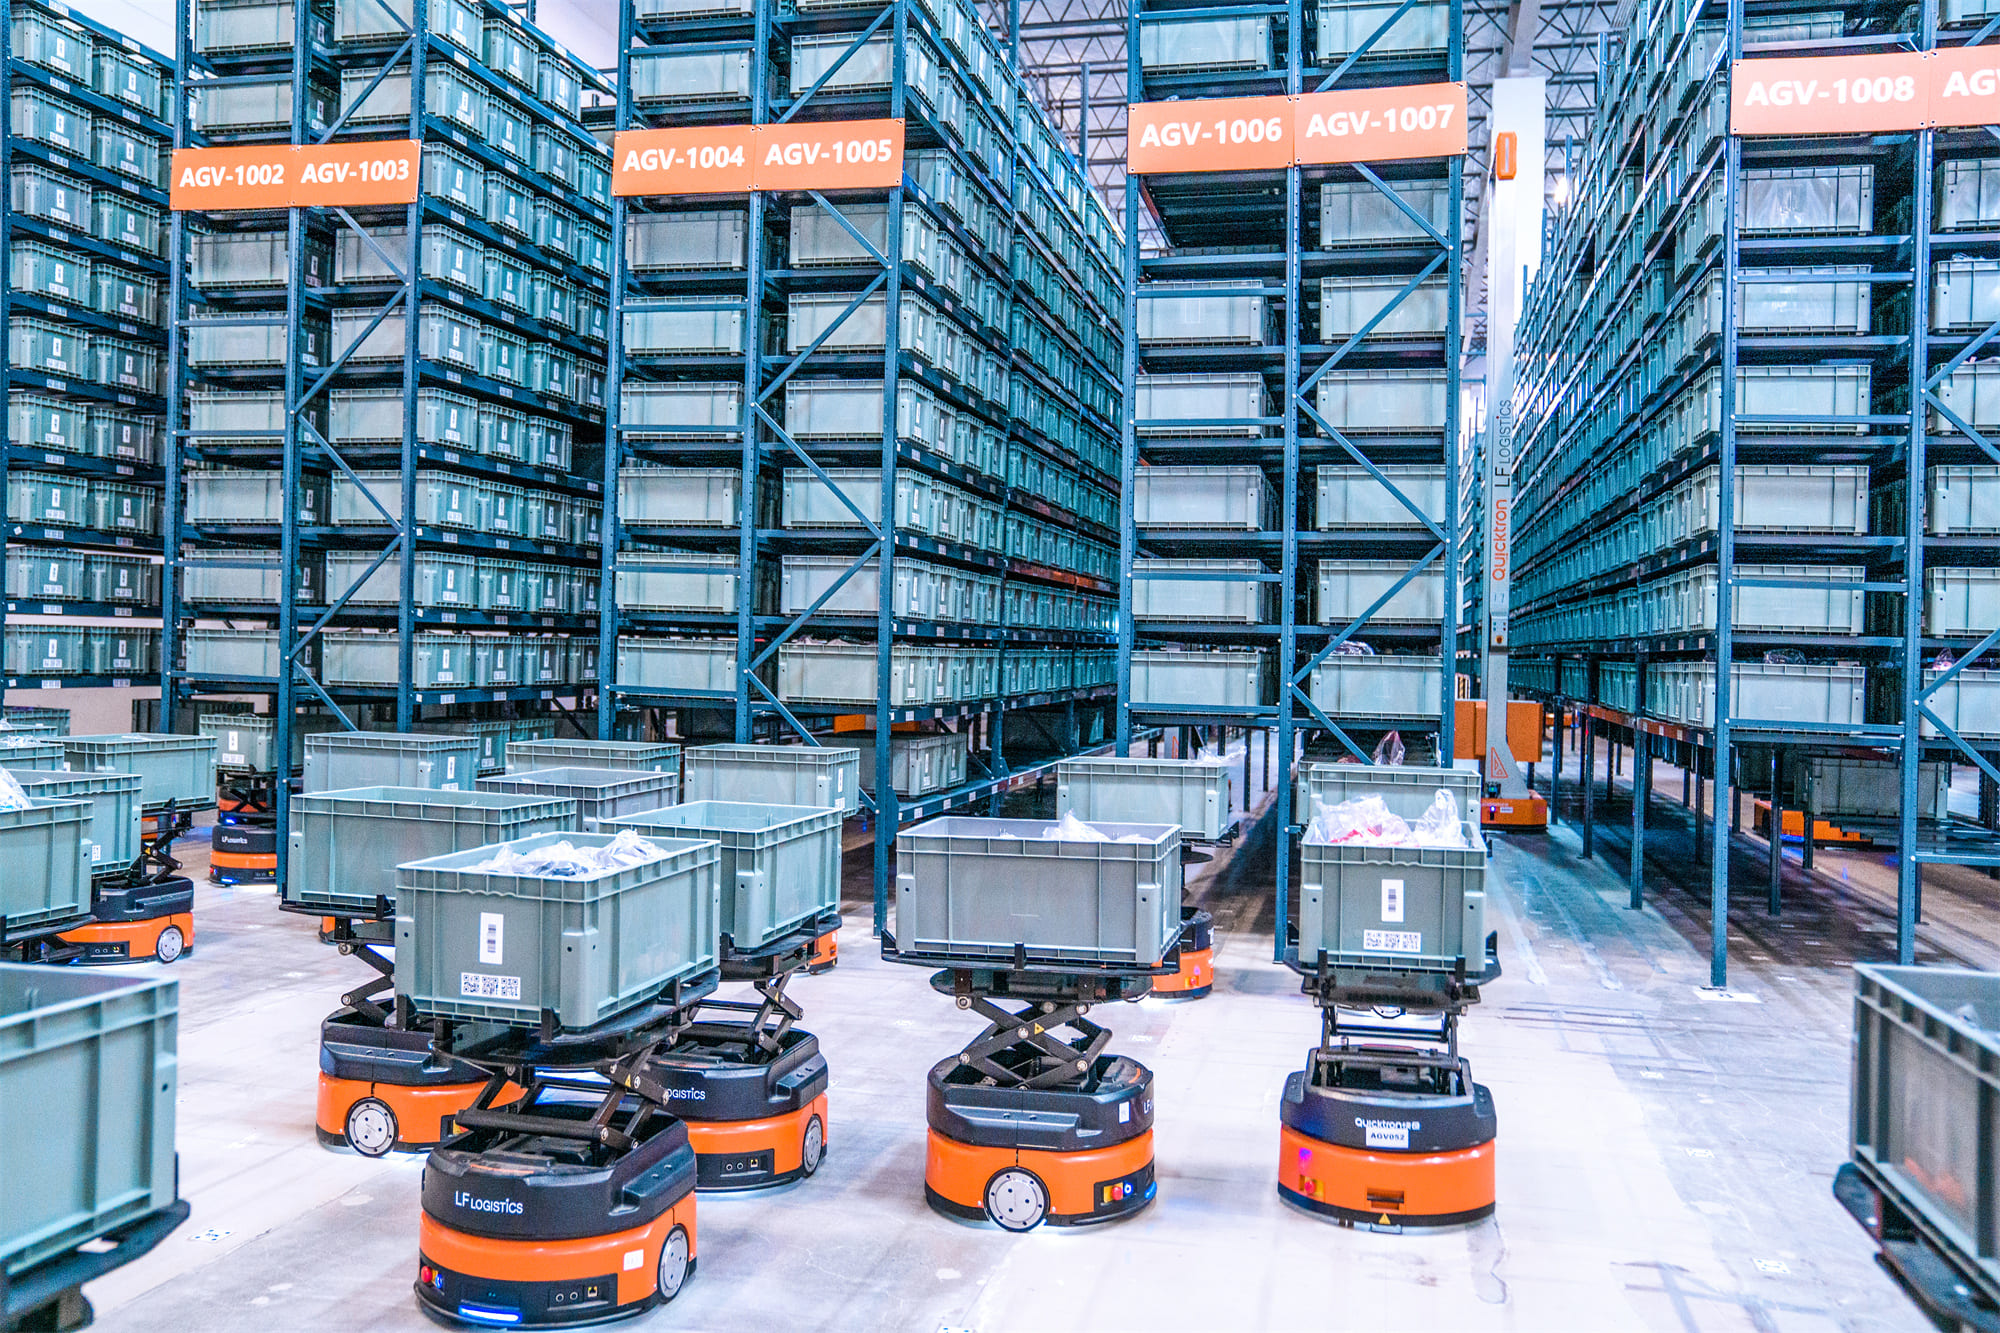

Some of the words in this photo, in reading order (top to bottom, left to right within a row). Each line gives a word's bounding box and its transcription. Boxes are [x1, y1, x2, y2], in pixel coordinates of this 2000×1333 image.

[1743, 75, 1915, 106] AGV-1008
[1942, 68, 2000, 98] AG
[1139, 117, 1282, 148] AGV-1006
[1305, 104, 1455, 138] AGV-1007
[622, 145, 745, 172] AGV-1004
[764, 139, 892, 167] AGV-1005
[179, 164, 285, 188] AGV-1002
[300, 159, 410, 184] AGV-1003
[1496, 399, 1511, 465] LOGISTICS
[1494, 466, 1510, 487] LF
[1492, 499, 1508, 582] Quicktron
[666, 1087, 706, 1100] OGISTICS
[455, 1190, 470, 1207] LF
[470, 1197, 524, 1214] LOGISTICS
